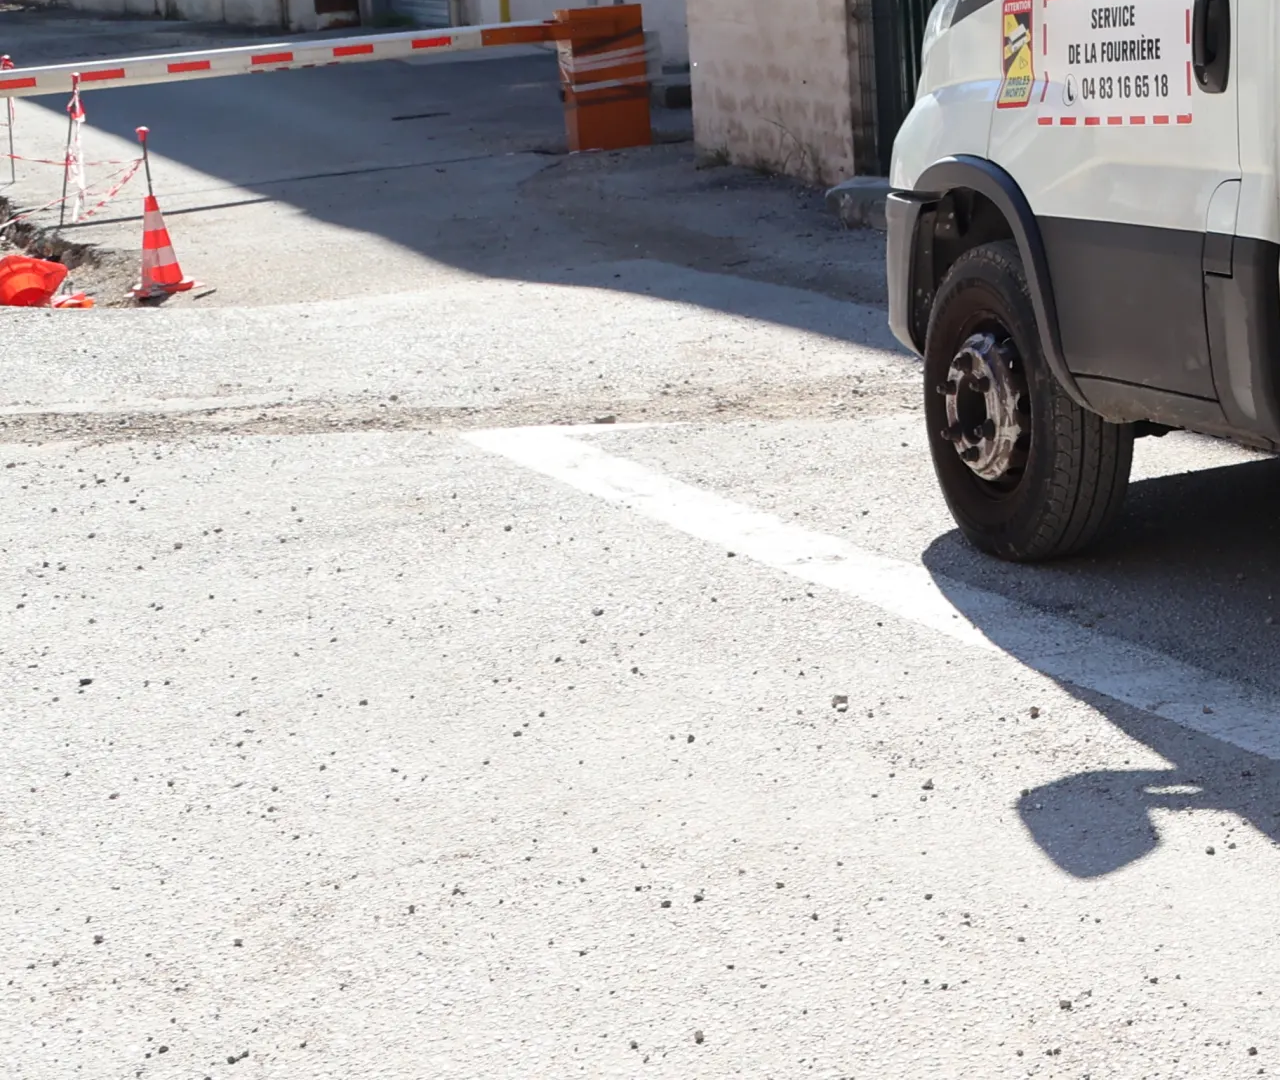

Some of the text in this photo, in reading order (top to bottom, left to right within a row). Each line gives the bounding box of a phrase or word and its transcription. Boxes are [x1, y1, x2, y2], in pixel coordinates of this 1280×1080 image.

[1004, 0, 1031, 13] ATTENTION
[1091, 5, 1136, 30] SERVICE
[1068, 34, 1161, 65] DE LA FOURRIÈRE
[1082, 74, 1169, 100] 04 83 16 65 18
